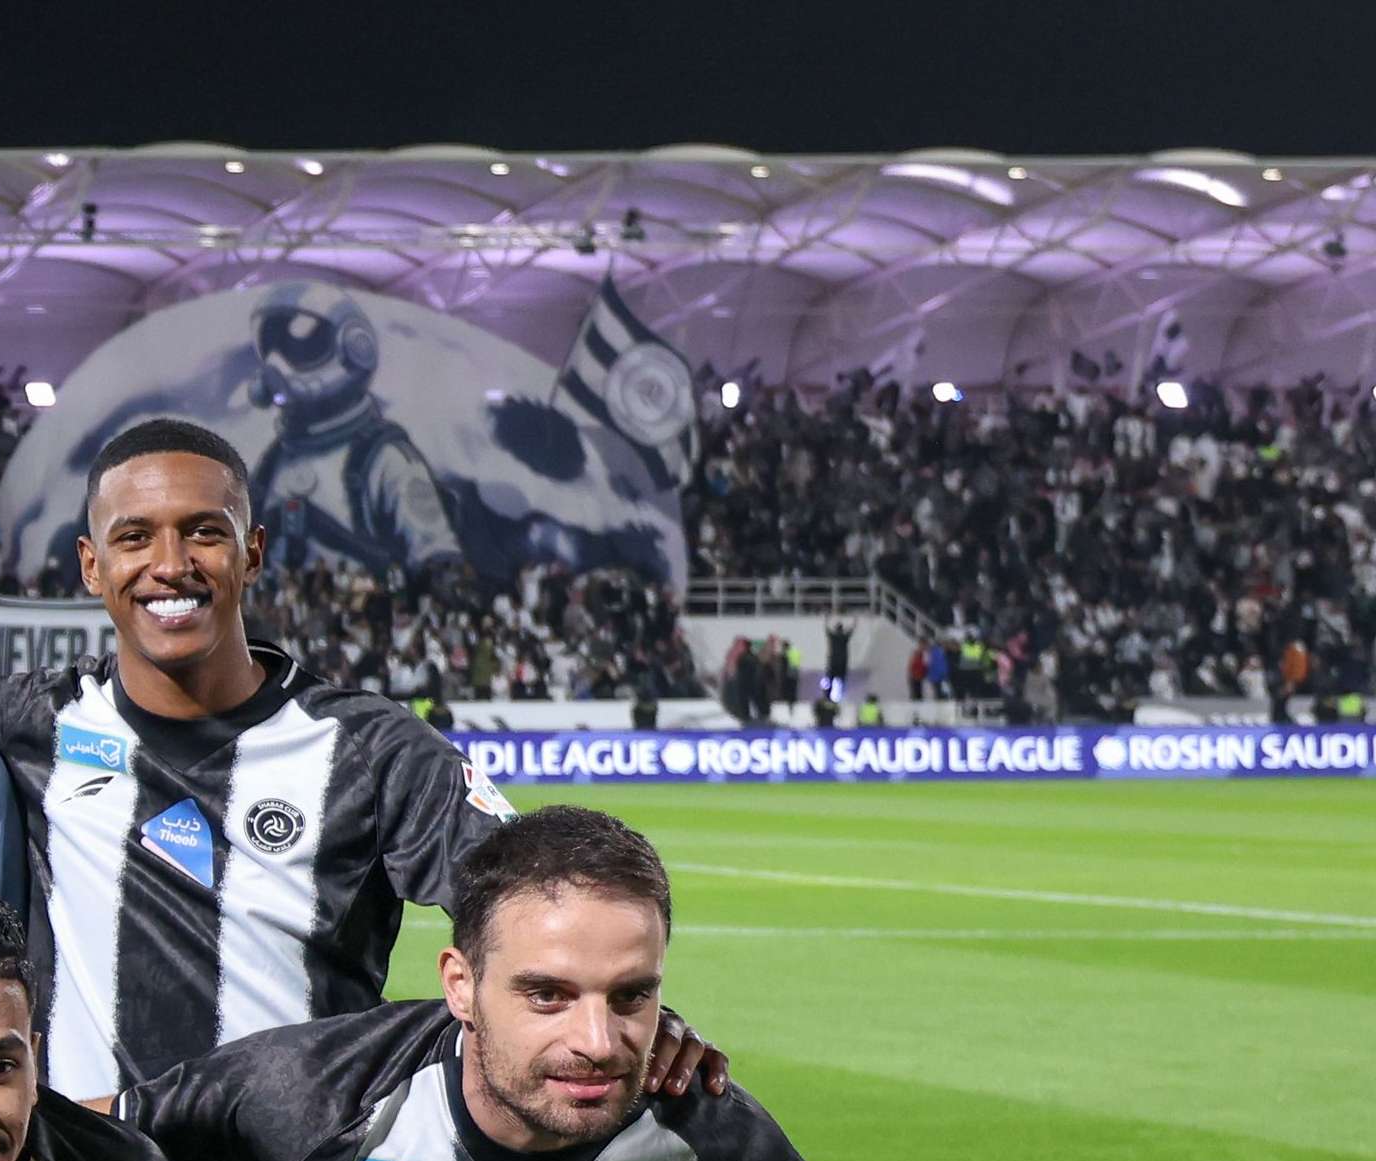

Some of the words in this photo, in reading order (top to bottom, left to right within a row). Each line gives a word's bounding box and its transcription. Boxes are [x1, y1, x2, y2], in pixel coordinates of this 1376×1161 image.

[522, 739, 661, 776] LEAGUE
[698, 736, 827, 775] ROSHN
[832, 735, 943, 773] SAUDI
[948, 735, 1082, 772] LEAGUE
[1128, 734, 1256, 771] ROSHN
[1260, 733, 1368, 769] SAUDI
[257, 800, 284, 810] SHABAB
[284, 805, 299, 818] CLUB
[161, 814, 201, 833] ذيب
[159, 828, 199, 848] Theeb
